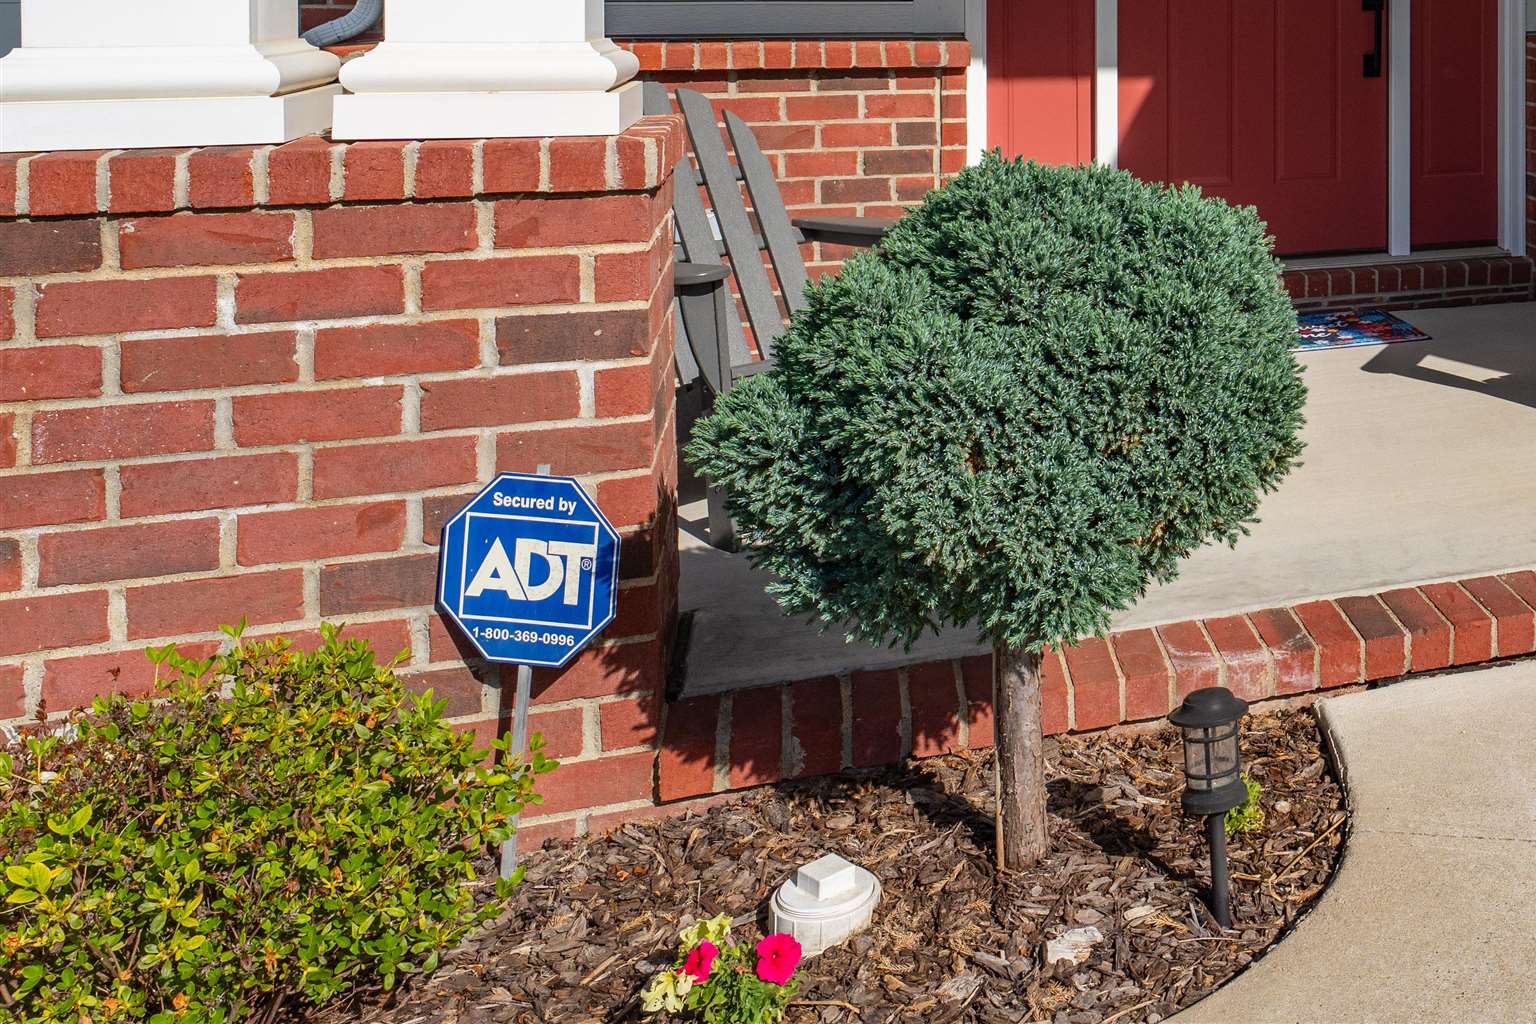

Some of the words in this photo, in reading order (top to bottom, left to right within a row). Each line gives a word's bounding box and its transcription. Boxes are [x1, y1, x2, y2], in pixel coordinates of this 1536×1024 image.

[493, 491, 554, 511] Secured
[558, 496, 577, 516] by
[472, 626, 575, 647] 1-800-369-0996
